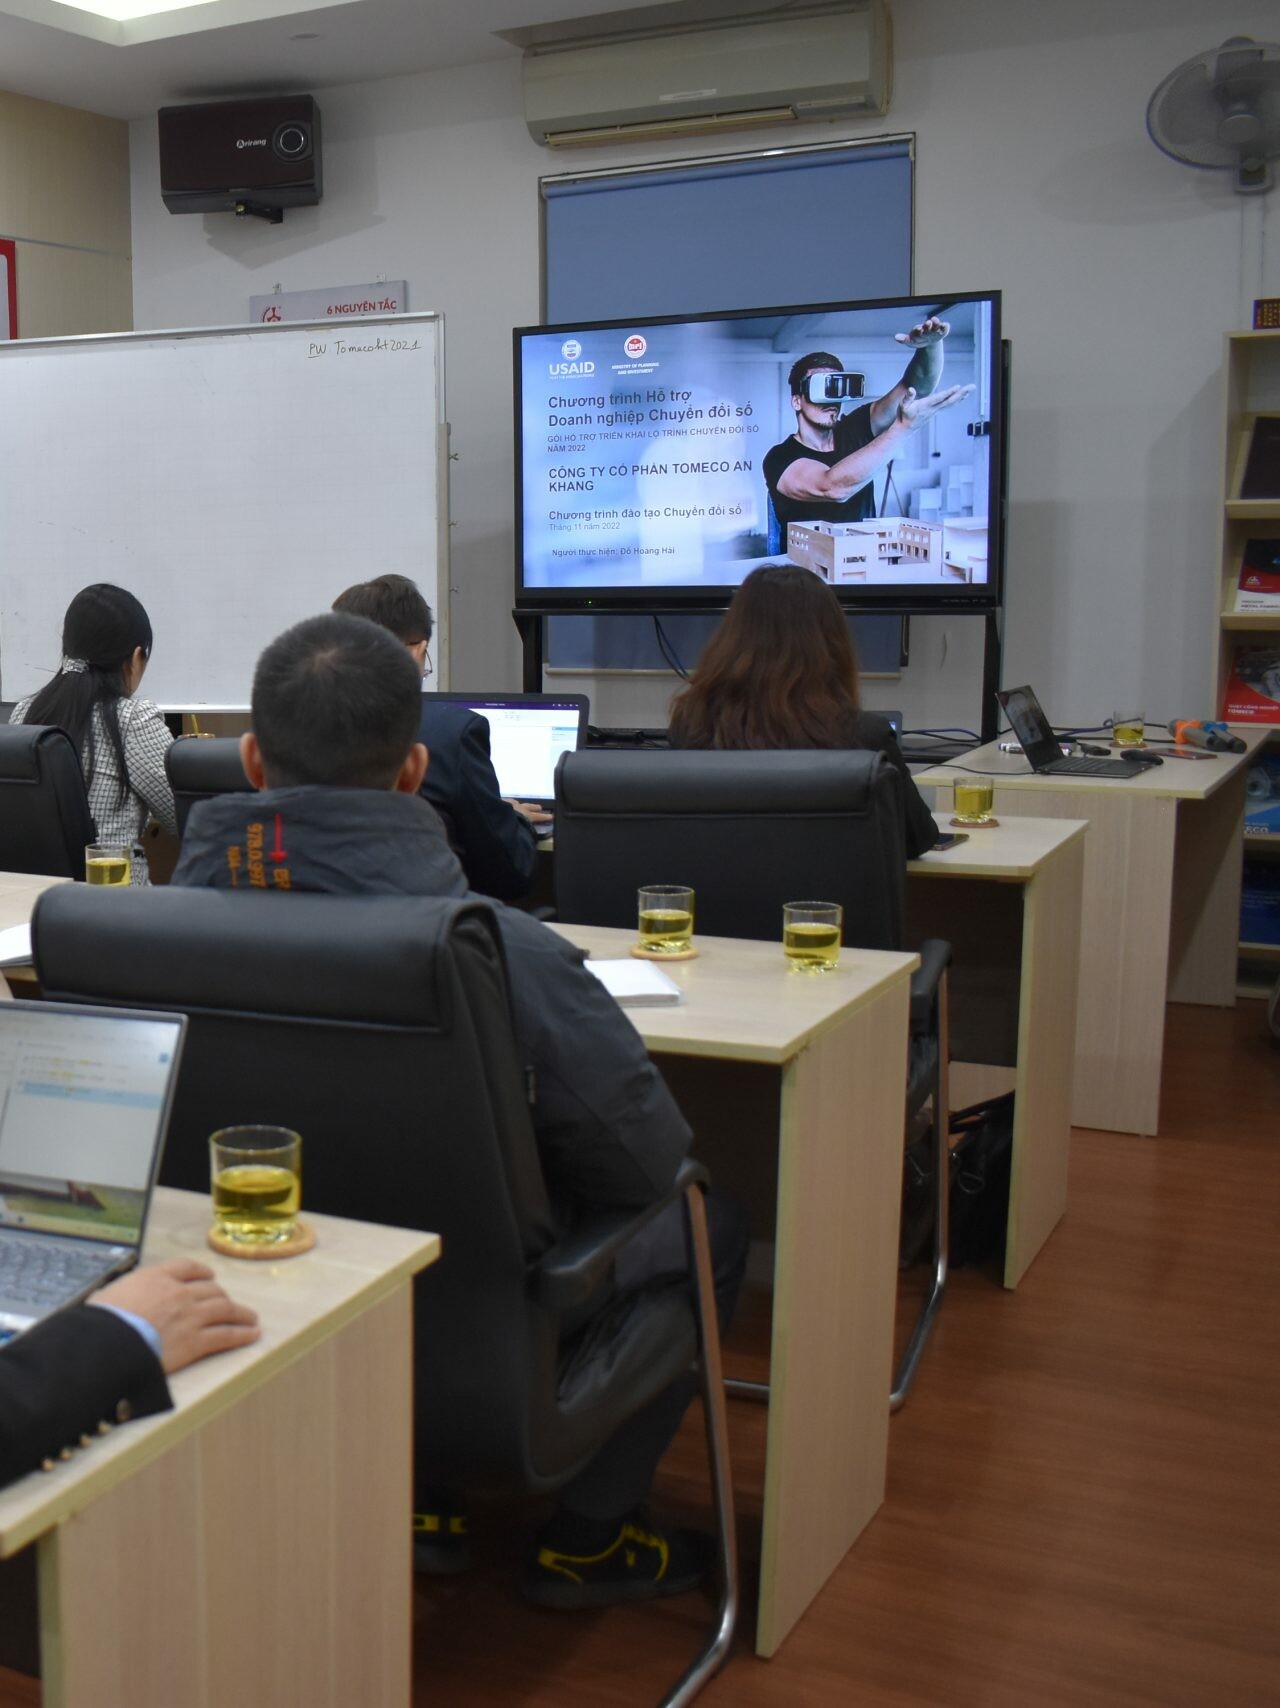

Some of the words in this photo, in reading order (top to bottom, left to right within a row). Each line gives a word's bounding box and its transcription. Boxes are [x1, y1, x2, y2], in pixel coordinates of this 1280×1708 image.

[326, 305, 333, 315] 6
[334, 300, 376, 314] NGUYÊN
[548, 361, 595, 376] USAID
[548, 395, 605, 409] Chương
[670, 390, 692, 405] trợ
[548, 413, 592, 427] Doanh
[597, 408, 644, 427] nghiệp
[648, 404, 703, 423] Chuyển
[735, 400, 753, 417] số
[625, 430, 646, 439] KHAI
[567, 444, 586, 452] 2022
[548, 465, 586, 479] CÔNG
[590, 466, 605, 478] TY
[672, 461, 730, 474] TOMECO
[733, 460, 753, 472] AN
[548, 481, 595, 492] KHANG
[548, 510, 592, 521] Chương
[644, 508, 661, 520] tạo
[663, 504, 705, 518] Chuyển
[728, 502, 742, 516] số
[602, 521, 621, 530] 2022
